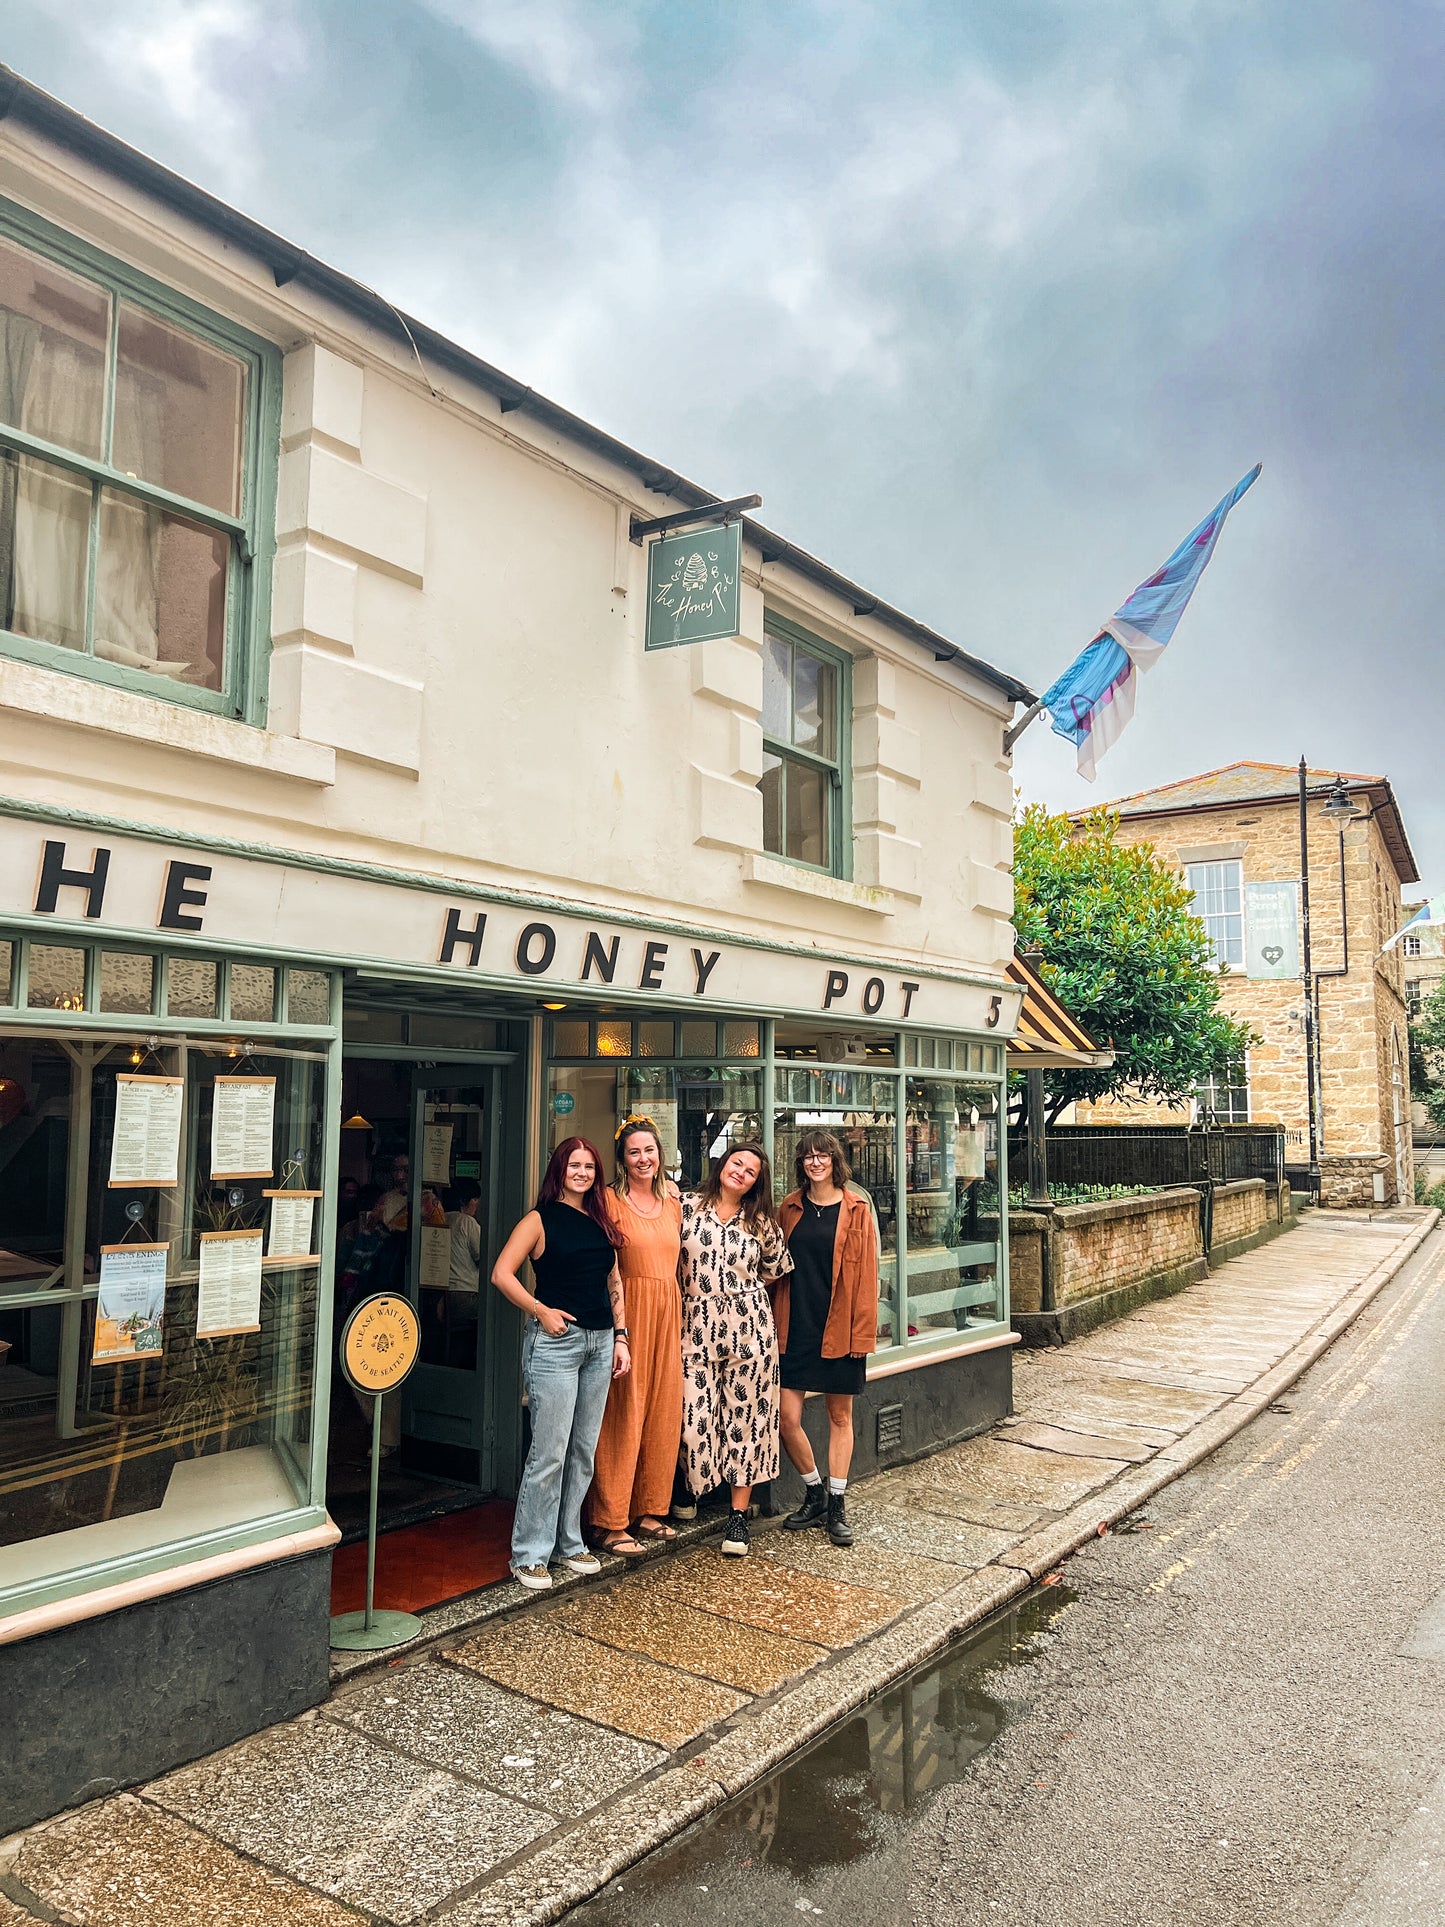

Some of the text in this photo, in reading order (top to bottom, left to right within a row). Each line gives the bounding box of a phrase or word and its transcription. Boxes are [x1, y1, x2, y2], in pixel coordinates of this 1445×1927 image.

[653, 572, 734, 623] The Honey Pot
[1248, 891, 1287, 901] Parade
[1248, 902, 1284, 911] Street
[438, 907, 721, 995] HONEY
[822, 970, 920, 1018] POT
[985, 996, 1003, 1028] 5
[1265, 951, 1281, 959] PZ
[355, 1307, 410, 1349] PLEASE WAIT HERE
[359, 1352, 405, 1377] TO BE SEATED
